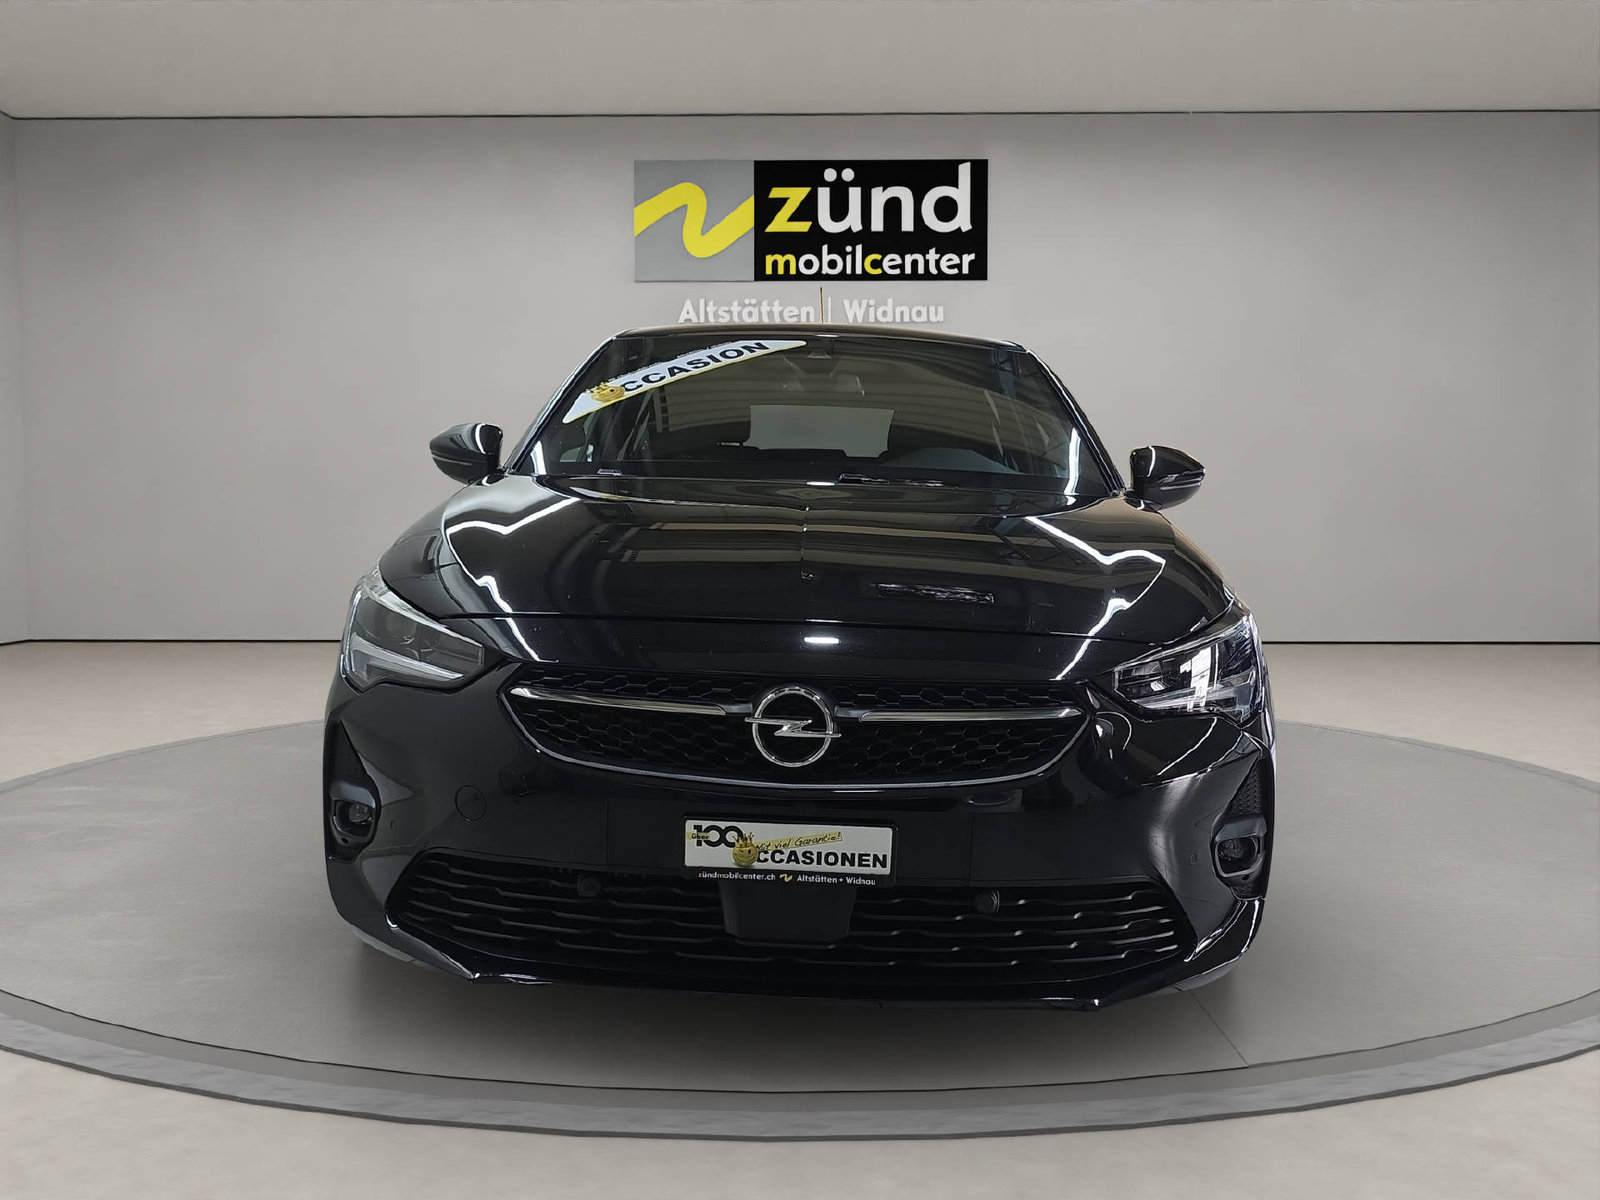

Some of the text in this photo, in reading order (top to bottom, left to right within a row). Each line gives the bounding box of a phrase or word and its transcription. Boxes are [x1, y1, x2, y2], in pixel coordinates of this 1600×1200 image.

[764, 161, 973, 234] zünd
[765, 244, 976, 275] mobilcenter
[678, 298, 816, 324] Altstätten
[843, 298, 944, 323] Widnau
[693, 824, 744, 848] 100
[698, 870, 776, 881] zündmobilcenter.ch
[797, 874, 838, 884] Altstätten
[845, 876, 876, 886] Widnau
